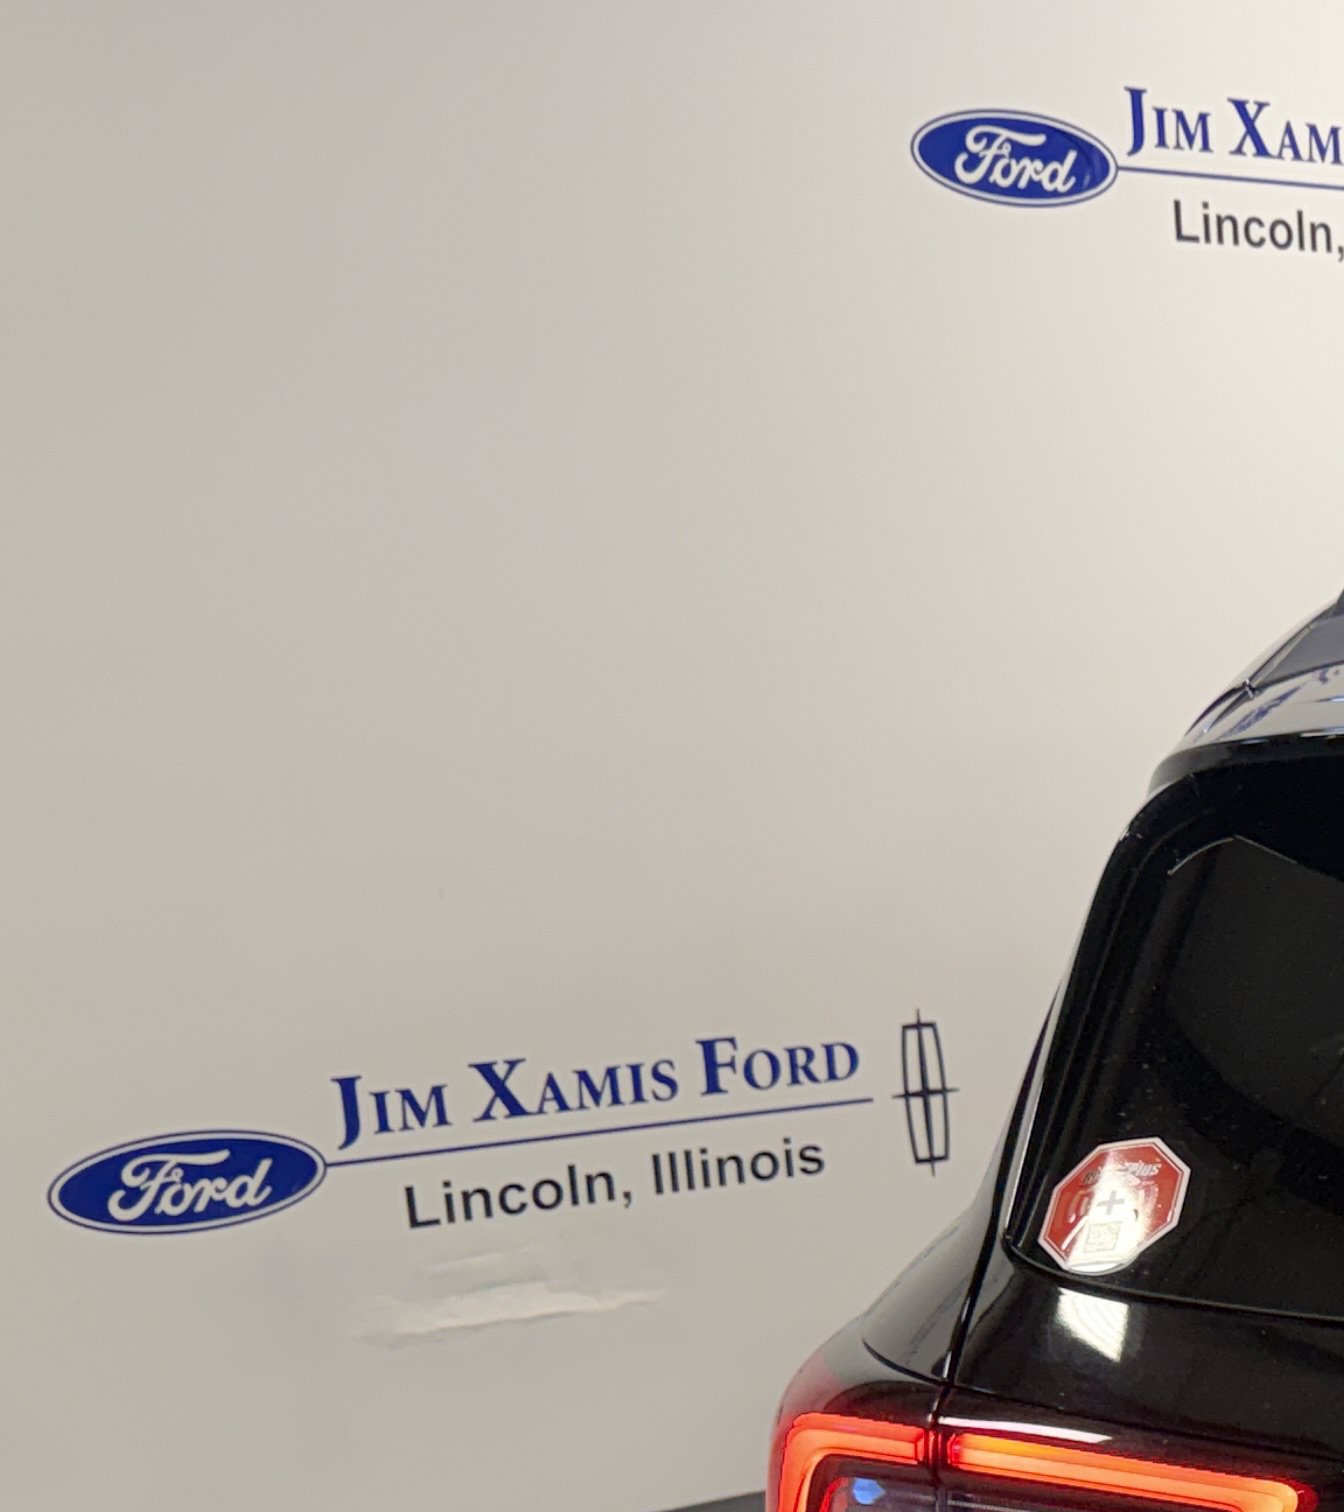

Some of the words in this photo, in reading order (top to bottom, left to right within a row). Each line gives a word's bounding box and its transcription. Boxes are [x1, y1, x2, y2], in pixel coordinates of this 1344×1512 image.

[1123, 86, 1213, 156] JIM
[953, 124, 1078, 194] Ford
[330, 1074, 453, 1150] JIM
[467, 1056, 680, 1124] XAMIS
[695, 1035, 861, 1096] FORD
[108, 1149, 274, 1222] Ford
[403, 1166, 634, 1230] Lincoln,
[651, 1137, 826, 1195] Illinois
